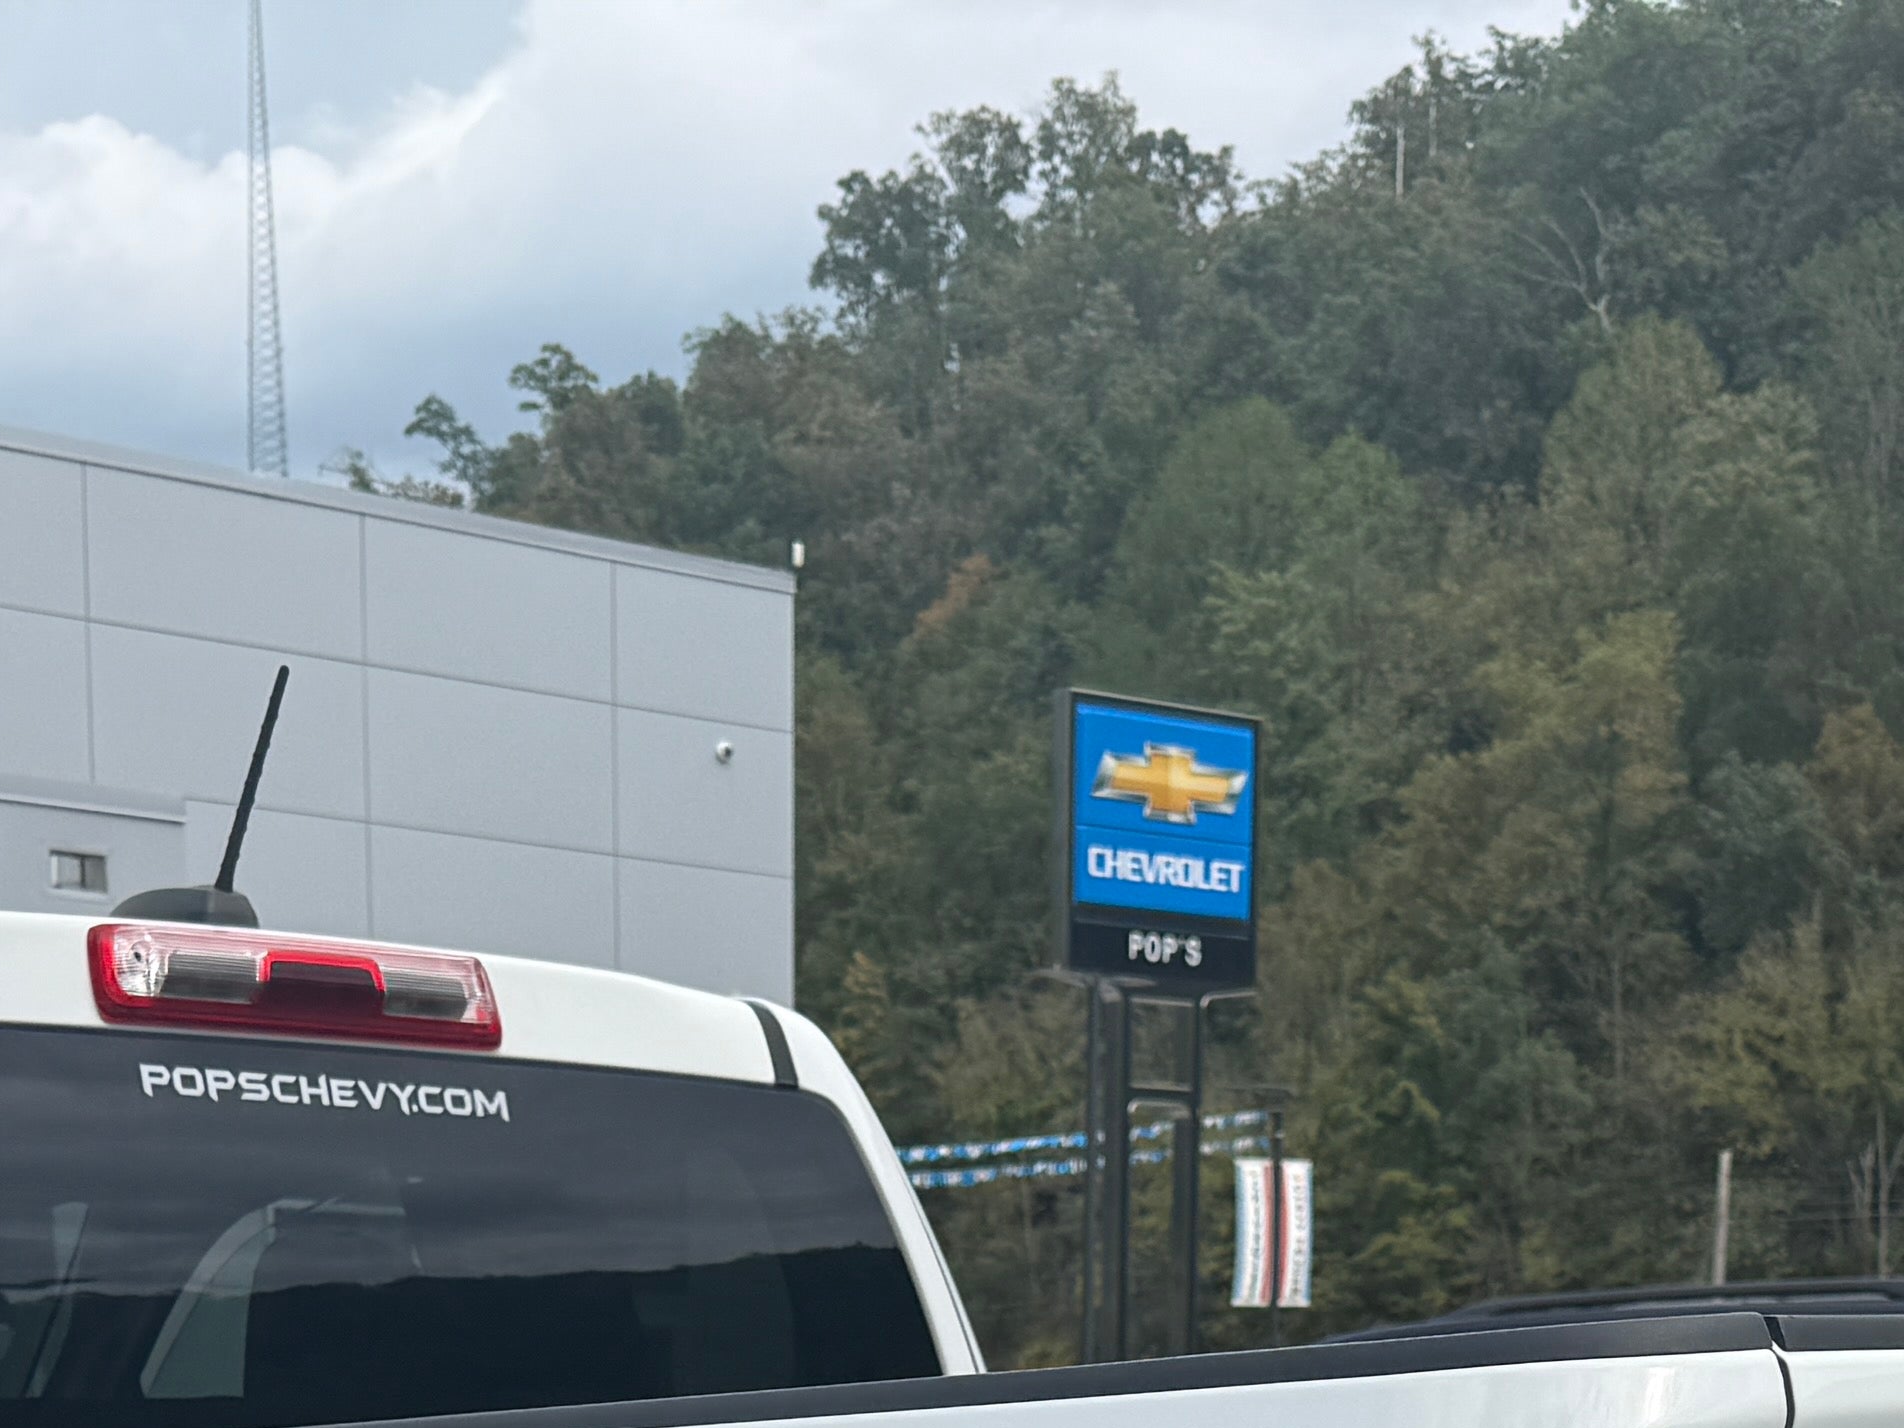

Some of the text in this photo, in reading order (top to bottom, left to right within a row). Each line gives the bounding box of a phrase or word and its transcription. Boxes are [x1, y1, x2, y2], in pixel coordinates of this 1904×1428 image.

[1087, 845, 1245, 893] CHEVROLET
[1128, 930, 1202, 967] POP'S
[139, 1063, 511, 1122] POPSCHEVY.COM
